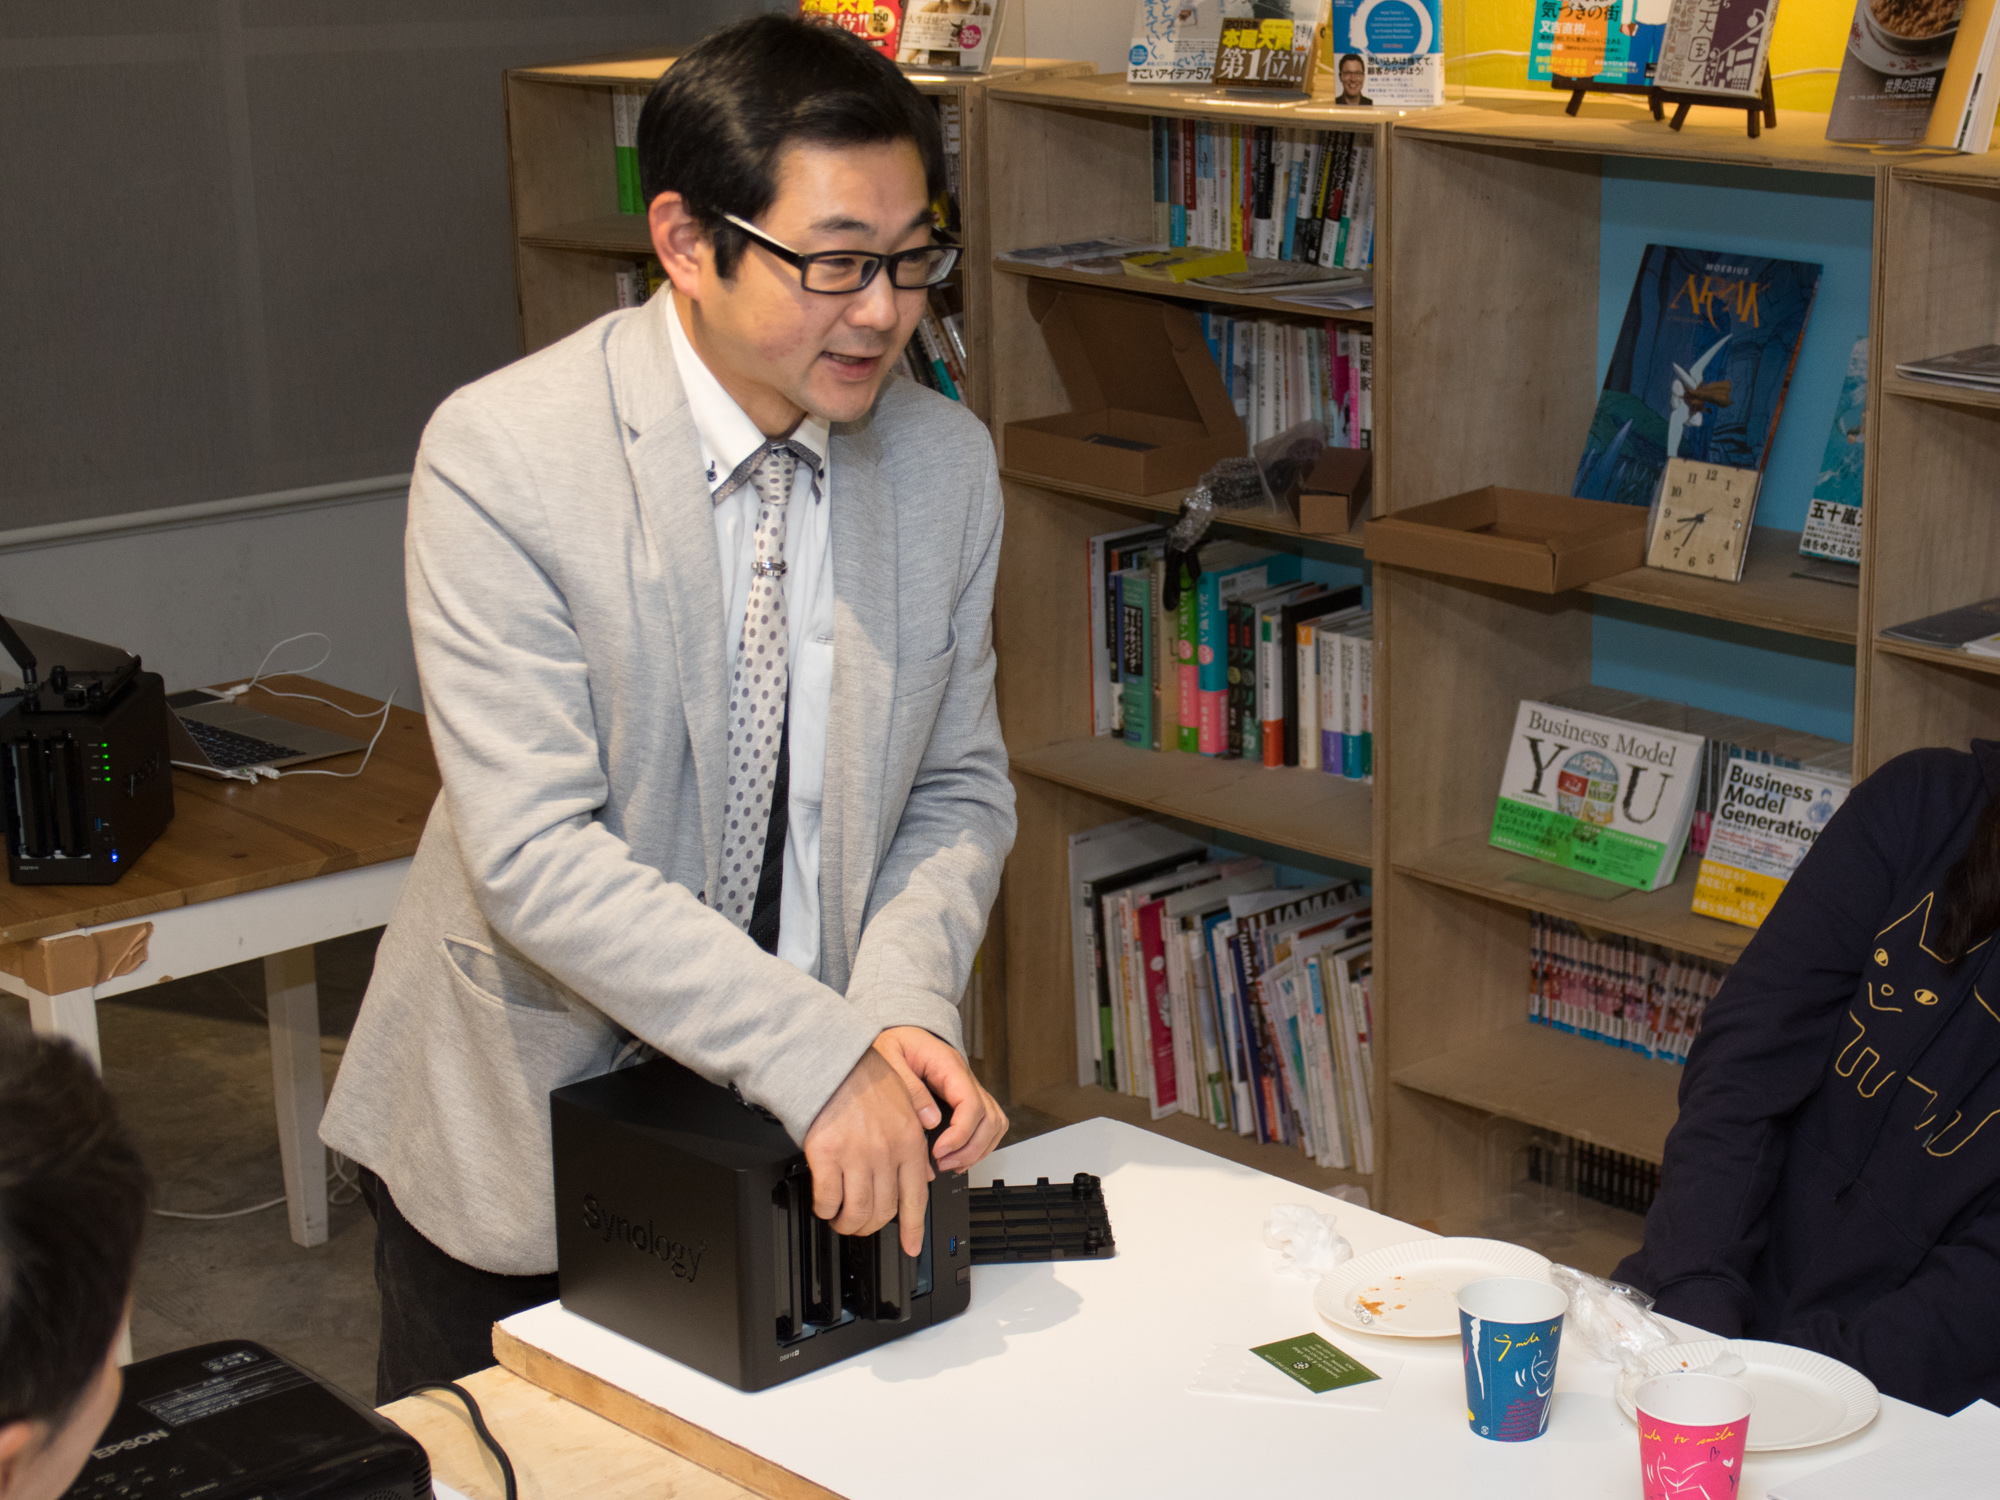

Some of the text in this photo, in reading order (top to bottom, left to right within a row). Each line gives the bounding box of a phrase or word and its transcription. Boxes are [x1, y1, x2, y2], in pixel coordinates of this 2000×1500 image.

[1541, 1, 1620, 22] 気づきの街
[1130, 67, 1212, 81] すごいアイデア57
[1884, 77, 1937, 93] 世界の豆料理
[1259, 152, 1269, 171] Jobs
[1705, 262, 1750, 276] MOEBIUS
[1687, 472, 1698, 484] 11
[1706, 469, 1719, 481] 12
[1671, 486, 1682, 497] 10
[1725, 479, 1731, 491] 1
[1733, 497, 1741, 509] 2
[1664, 508, 1672, 518] 9
[1664, 530, 1672, 541] 8
[1723, 540, 1730, 551] 4
[1673, 547, 1681, 558] 7
[1708, 553, 1716, 565] 5
[1688, 556, 1696, 567] 6
[1528, 709, 1678, 768] Business Model
[1729, 764, 1814, 803] Business
[1723, 783, 1786, 816] Model
[583, 1192, 703, 1283] Synology
[1696, 1426, 1735, 1446] smile
[91, 1428, 171, 1460] EPSON
